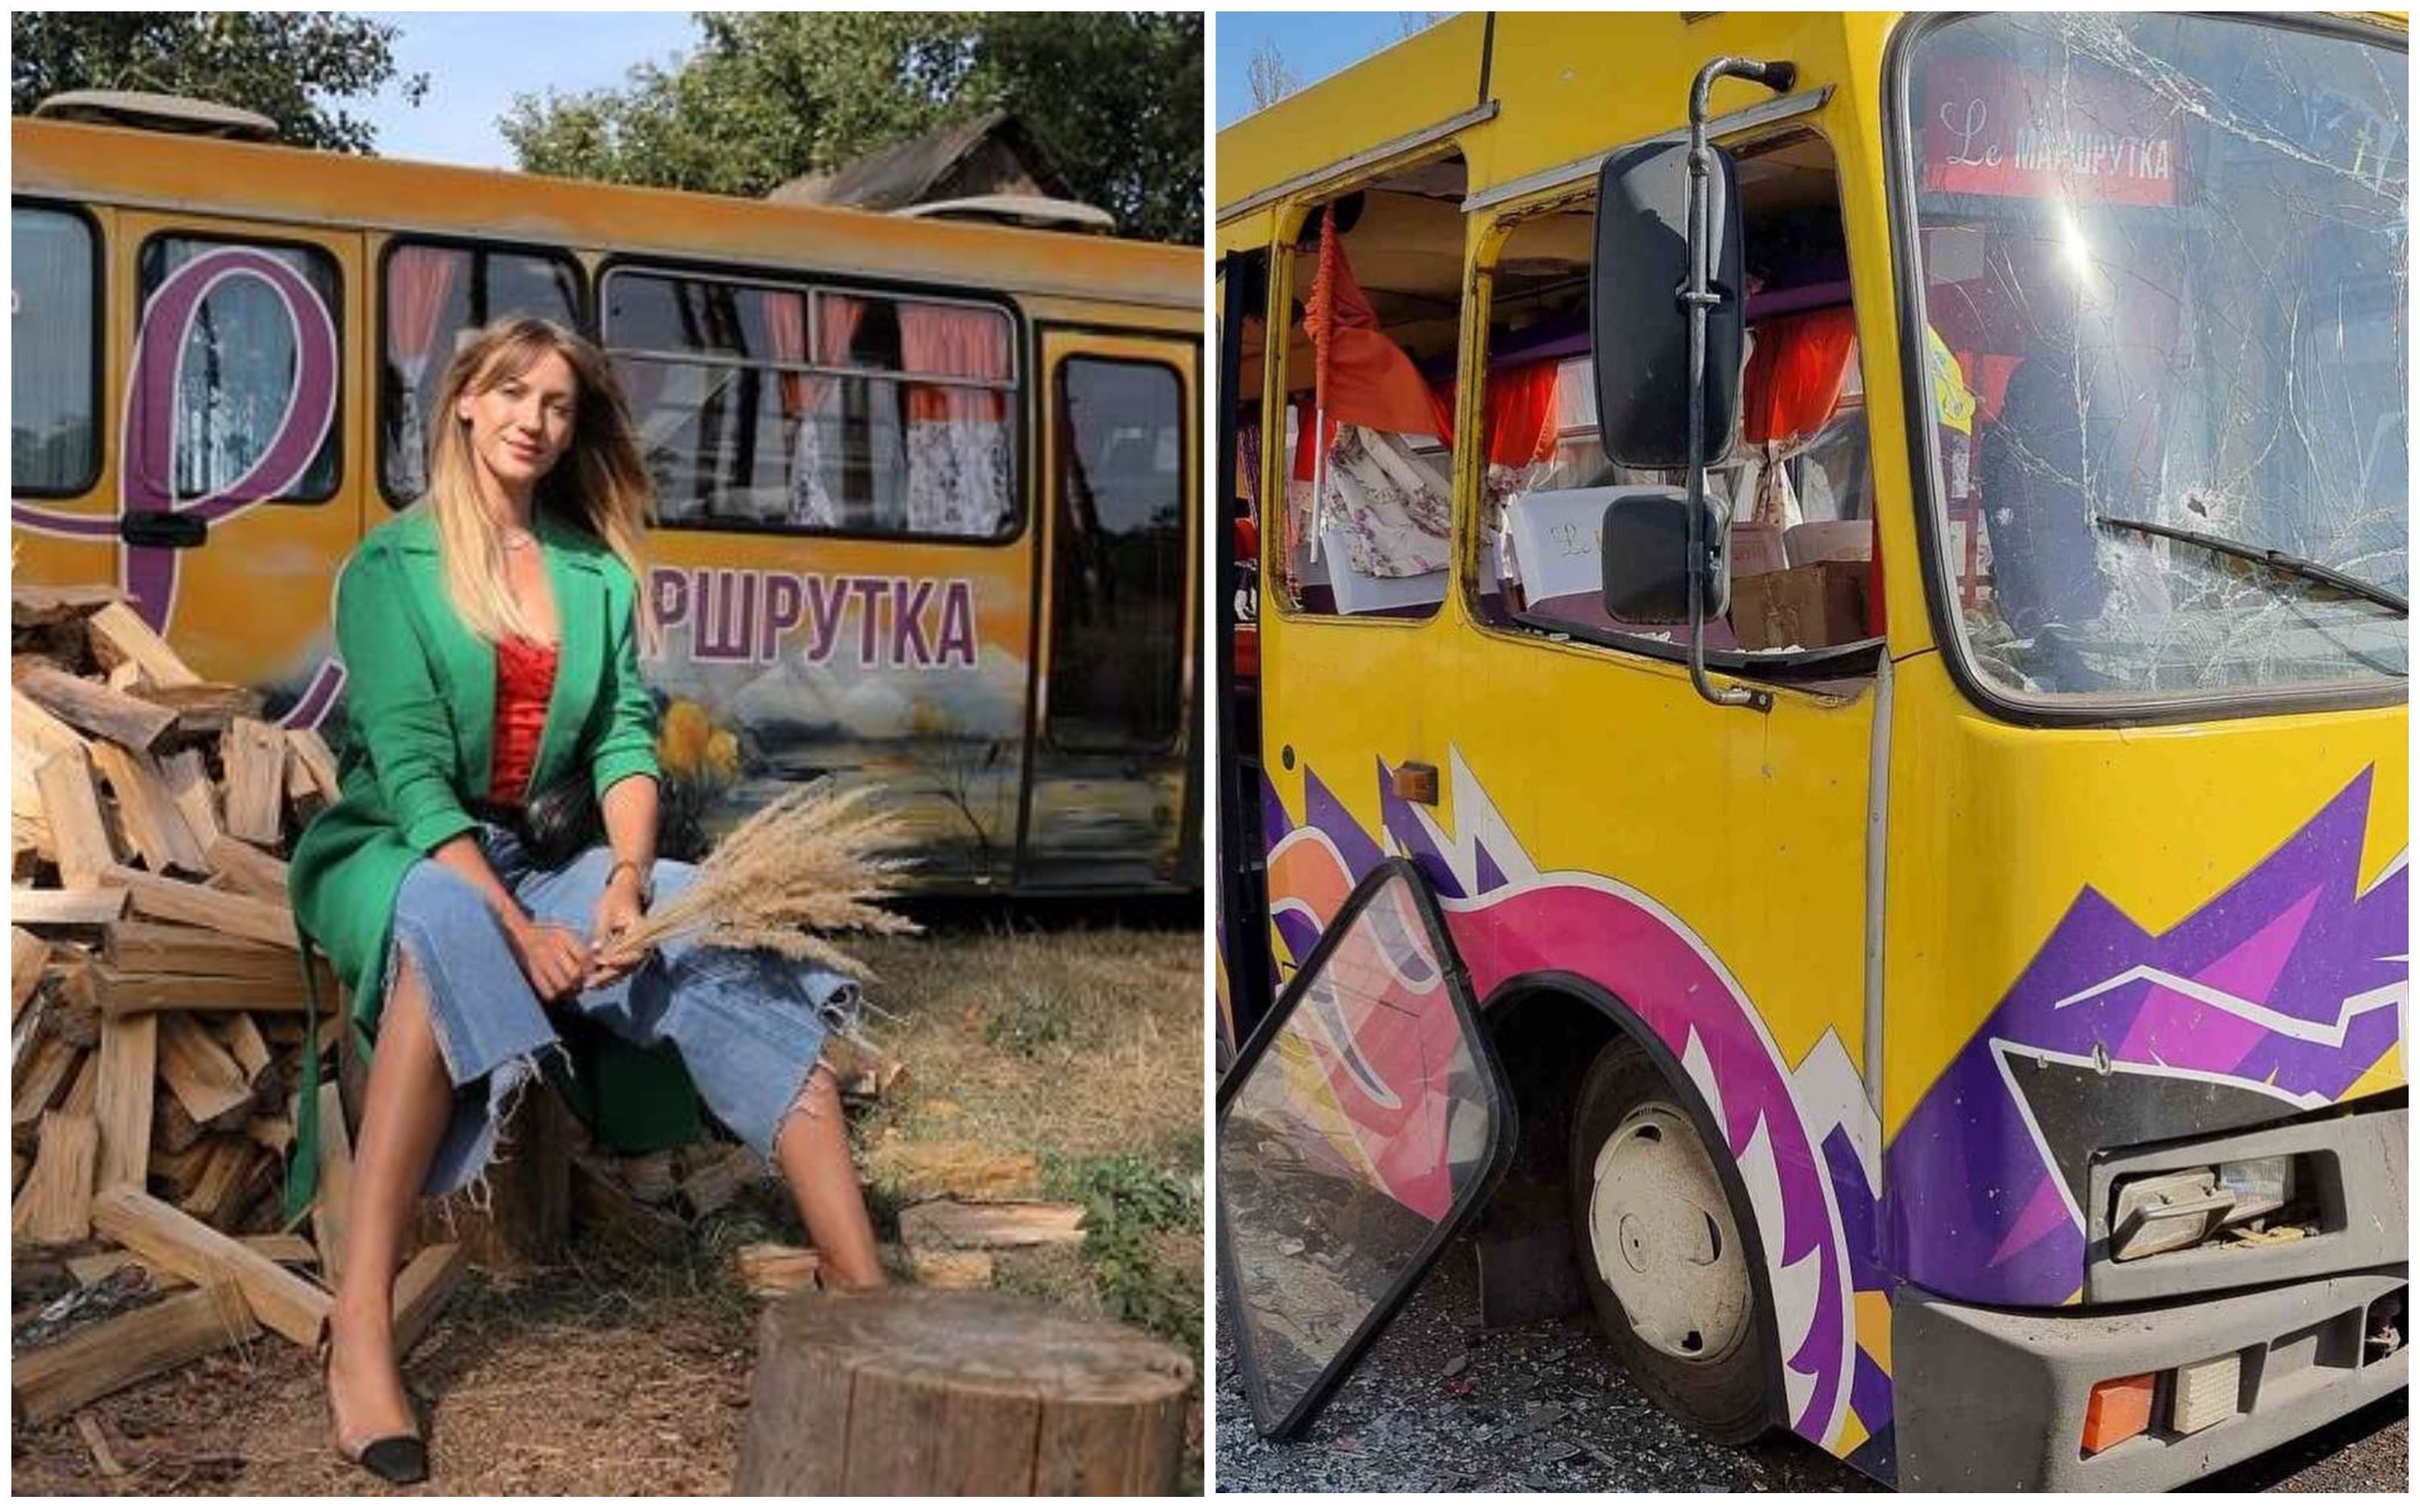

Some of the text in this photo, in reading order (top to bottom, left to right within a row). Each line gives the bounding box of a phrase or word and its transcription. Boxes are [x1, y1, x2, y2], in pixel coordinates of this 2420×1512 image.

[1940, 98, 2170, 179] Le МАРШРУТКА
[647, 567, 979, 671] РШРУТКА
